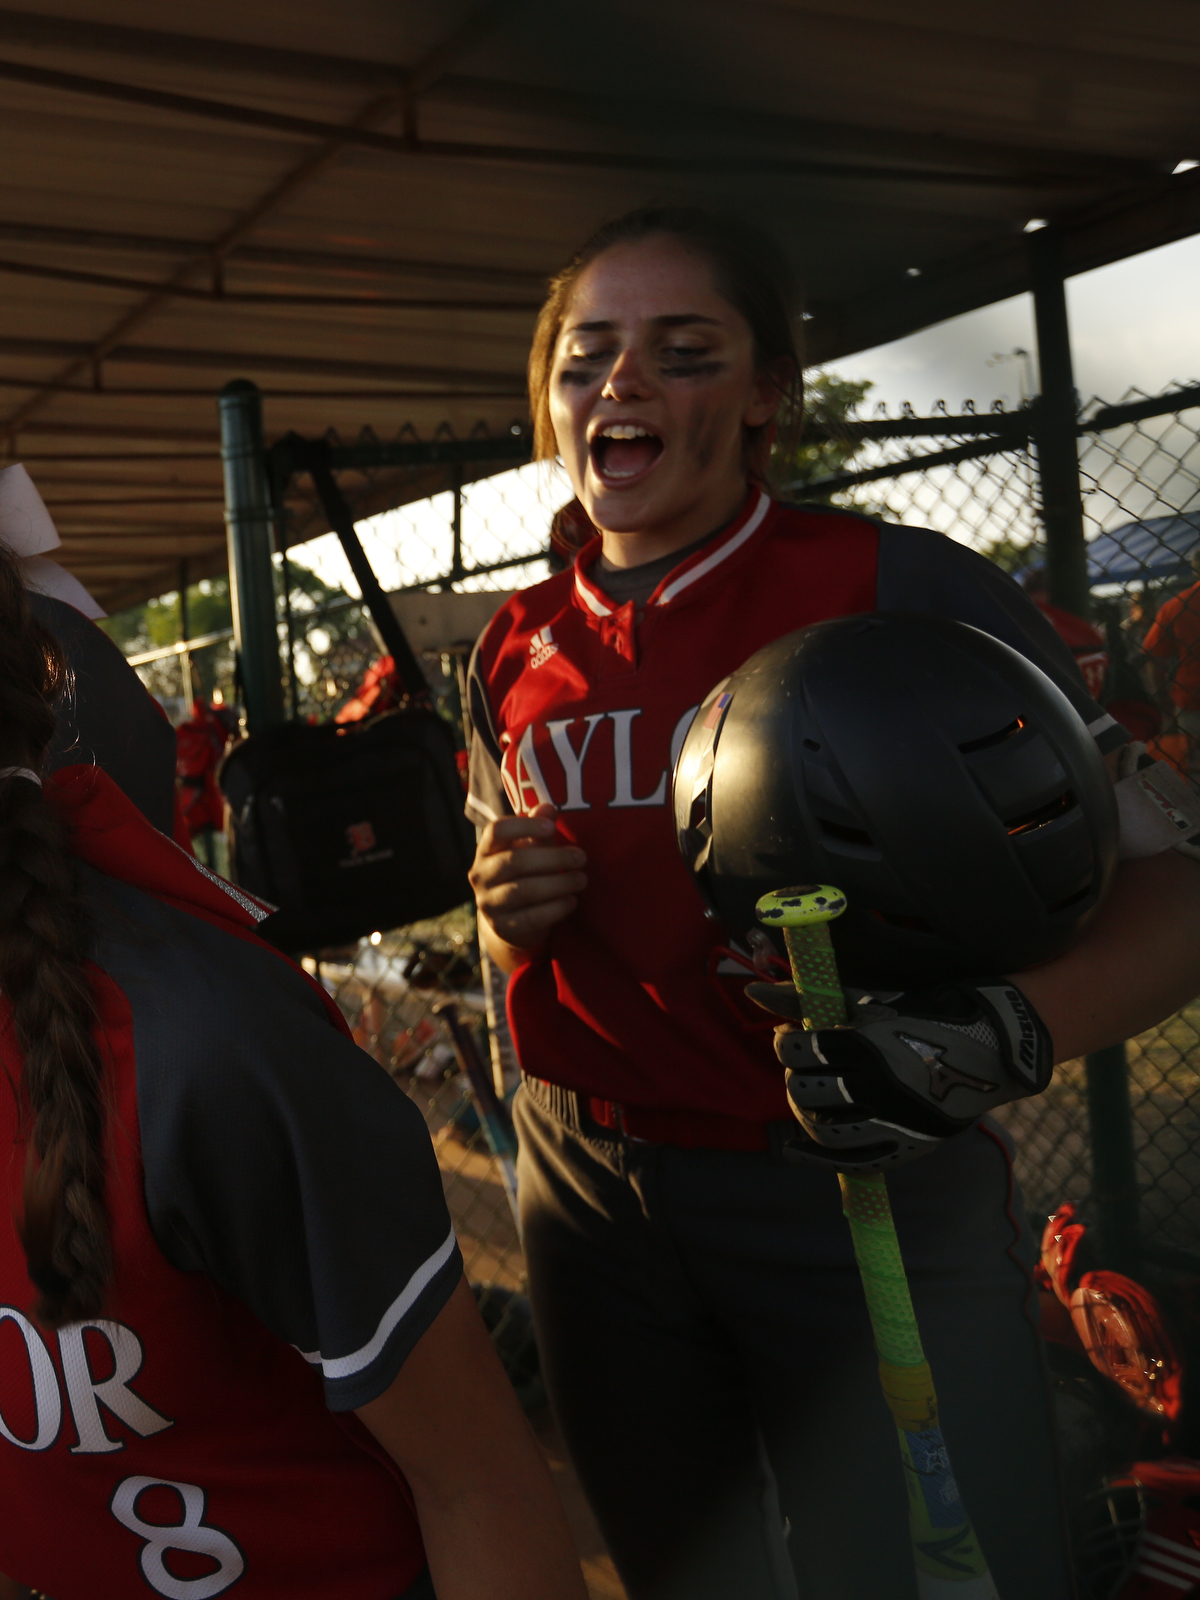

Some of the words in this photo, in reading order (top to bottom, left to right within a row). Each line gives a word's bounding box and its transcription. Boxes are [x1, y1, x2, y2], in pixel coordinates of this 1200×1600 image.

[531, 643, 559, 670] adidas
[501, 704, 699, 816] AYL
[108, 1474, 249, 1600] 8
